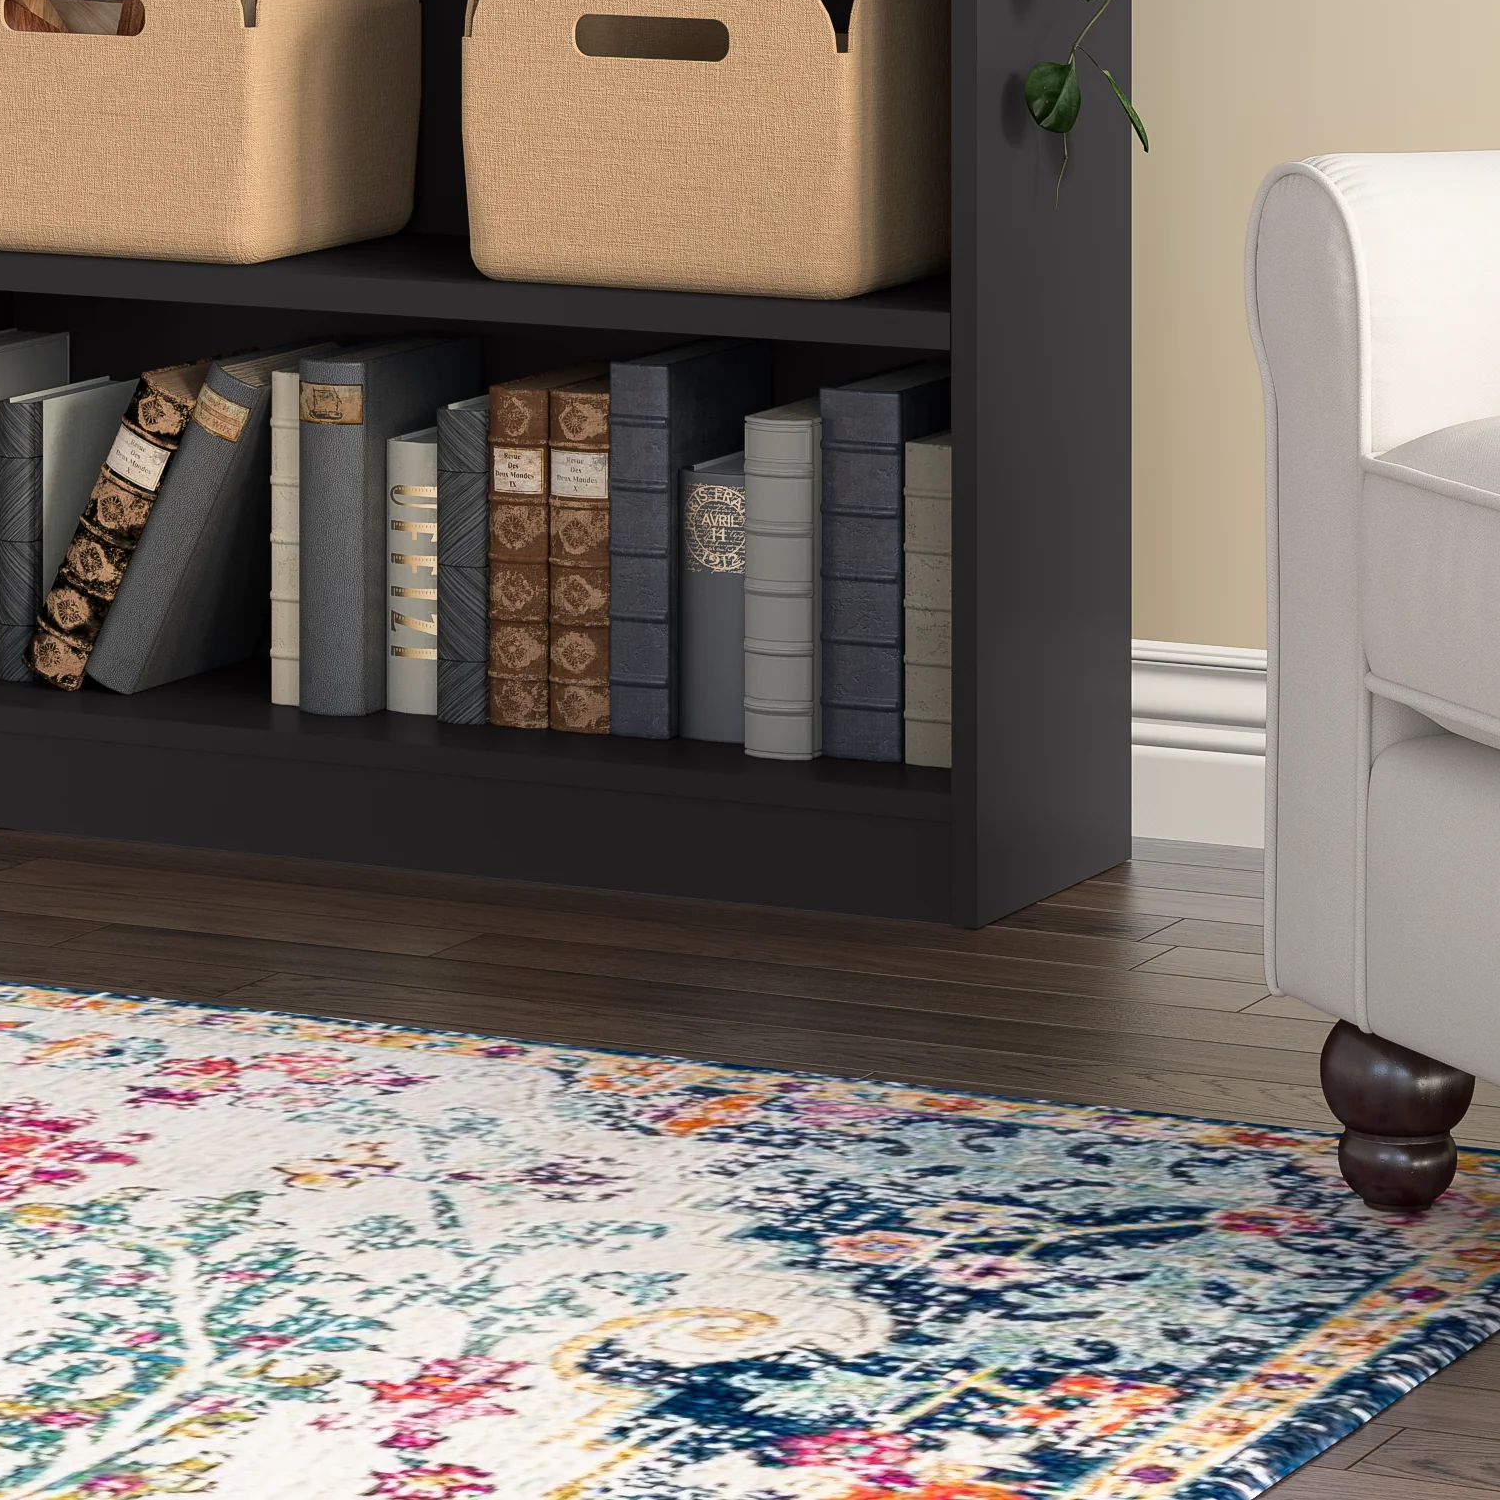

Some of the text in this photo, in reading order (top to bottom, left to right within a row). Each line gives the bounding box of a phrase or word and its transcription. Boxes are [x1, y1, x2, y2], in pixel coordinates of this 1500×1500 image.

[130, 449, 141, 459] Des
[495, 470, 534, 480] Deux Mondes
[570, 466, 582, 474] Des
[509, 480, 517, 488] IX
[556, 474, 598, 484] Deux Mondes
[684, 488, 708, 530] PARIS
[701, 513, 739, 527] AVRIL
[711, 527, 727, 542] 14
[702, 551, 740, 569] 1912
[390, 484, 438, 660] UFFIZI
